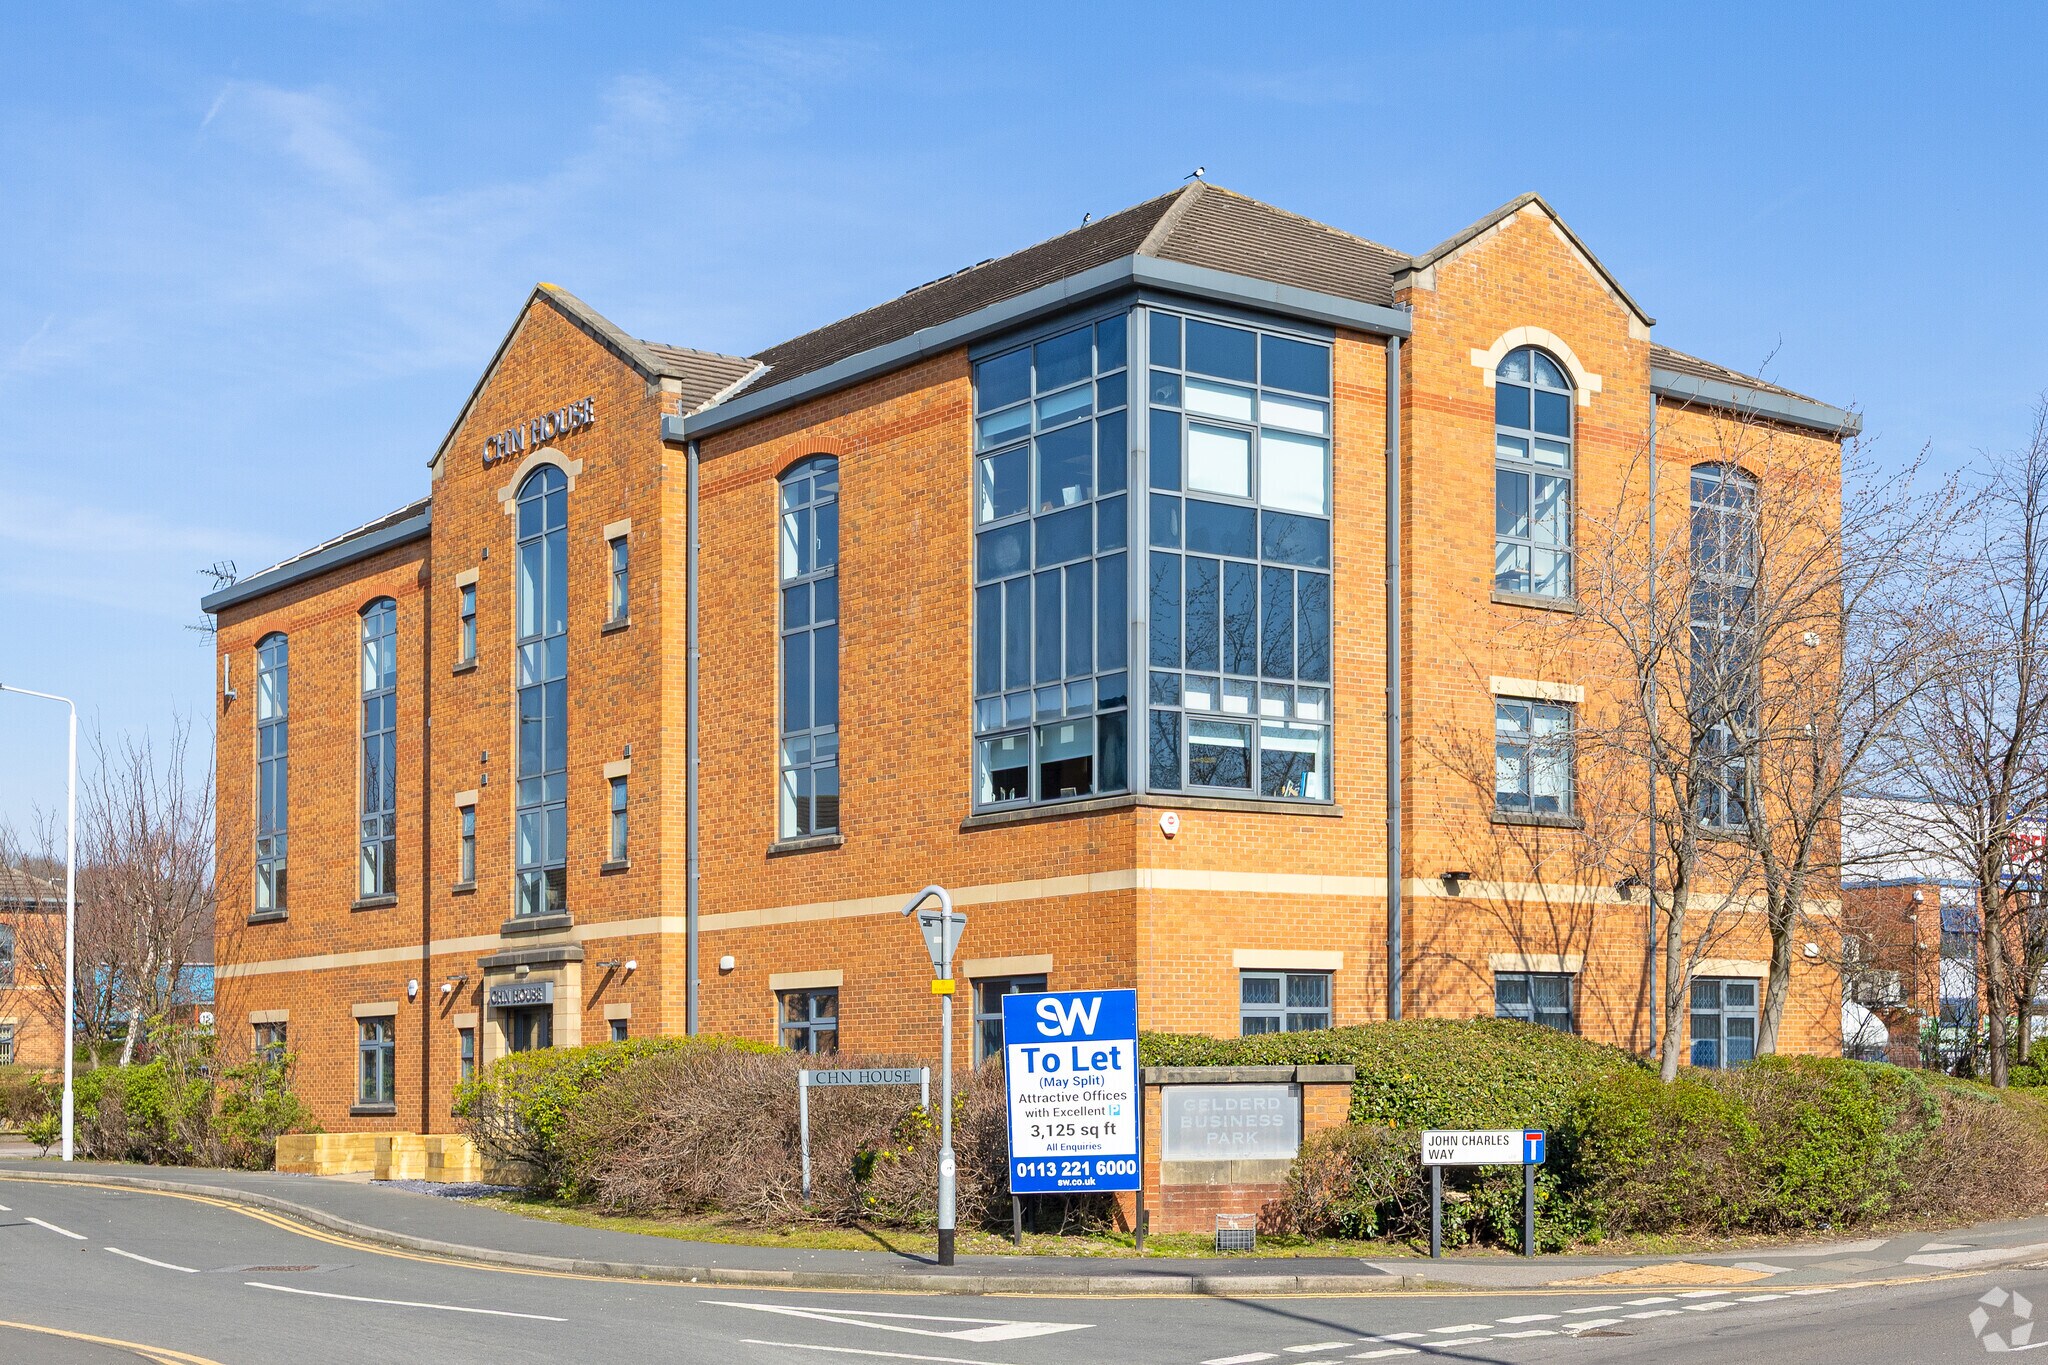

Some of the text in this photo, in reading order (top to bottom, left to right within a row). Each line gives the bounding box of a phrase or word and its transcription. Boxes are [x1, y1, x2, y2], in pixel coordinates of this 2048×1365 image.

[483, 396, 595, 462] CHN HOUSE
[491, 987, 543, 1005] CHN HOUSE
[1036, 997, 1102, 1037] SW
[1021, 1046, 1122, 1074] To Let
[816, 1070, 912, 1084] CHN HOUSE
[1039, 1075, 1105, 1089] (May Split)
[1018, 1090, 1127, 1104] Attractive Offices
[1183, 1097, 1280, 1112] GELDERD
[1025, 1107, 1049, 1118] with
[1053, 1106, 1105, 1117] Excellent
[1180, 1114, 1284, 1129] BUSINESS
[1030, 1122, 1116, 1139] 3,125 sq ft
[1206, 1131, 1258, 1145] PARK
[1428, 1135, 1510, 1147] JOHN CHARLES
[1046, 1142, 1102, 1152] All Enquiries
[1428, 1149, 1454, 1160] WAY
[1016, 1160, 1137, 1177] 0113 221 6000
[1057, 1177, 1096, 1187] sw.co.uk
